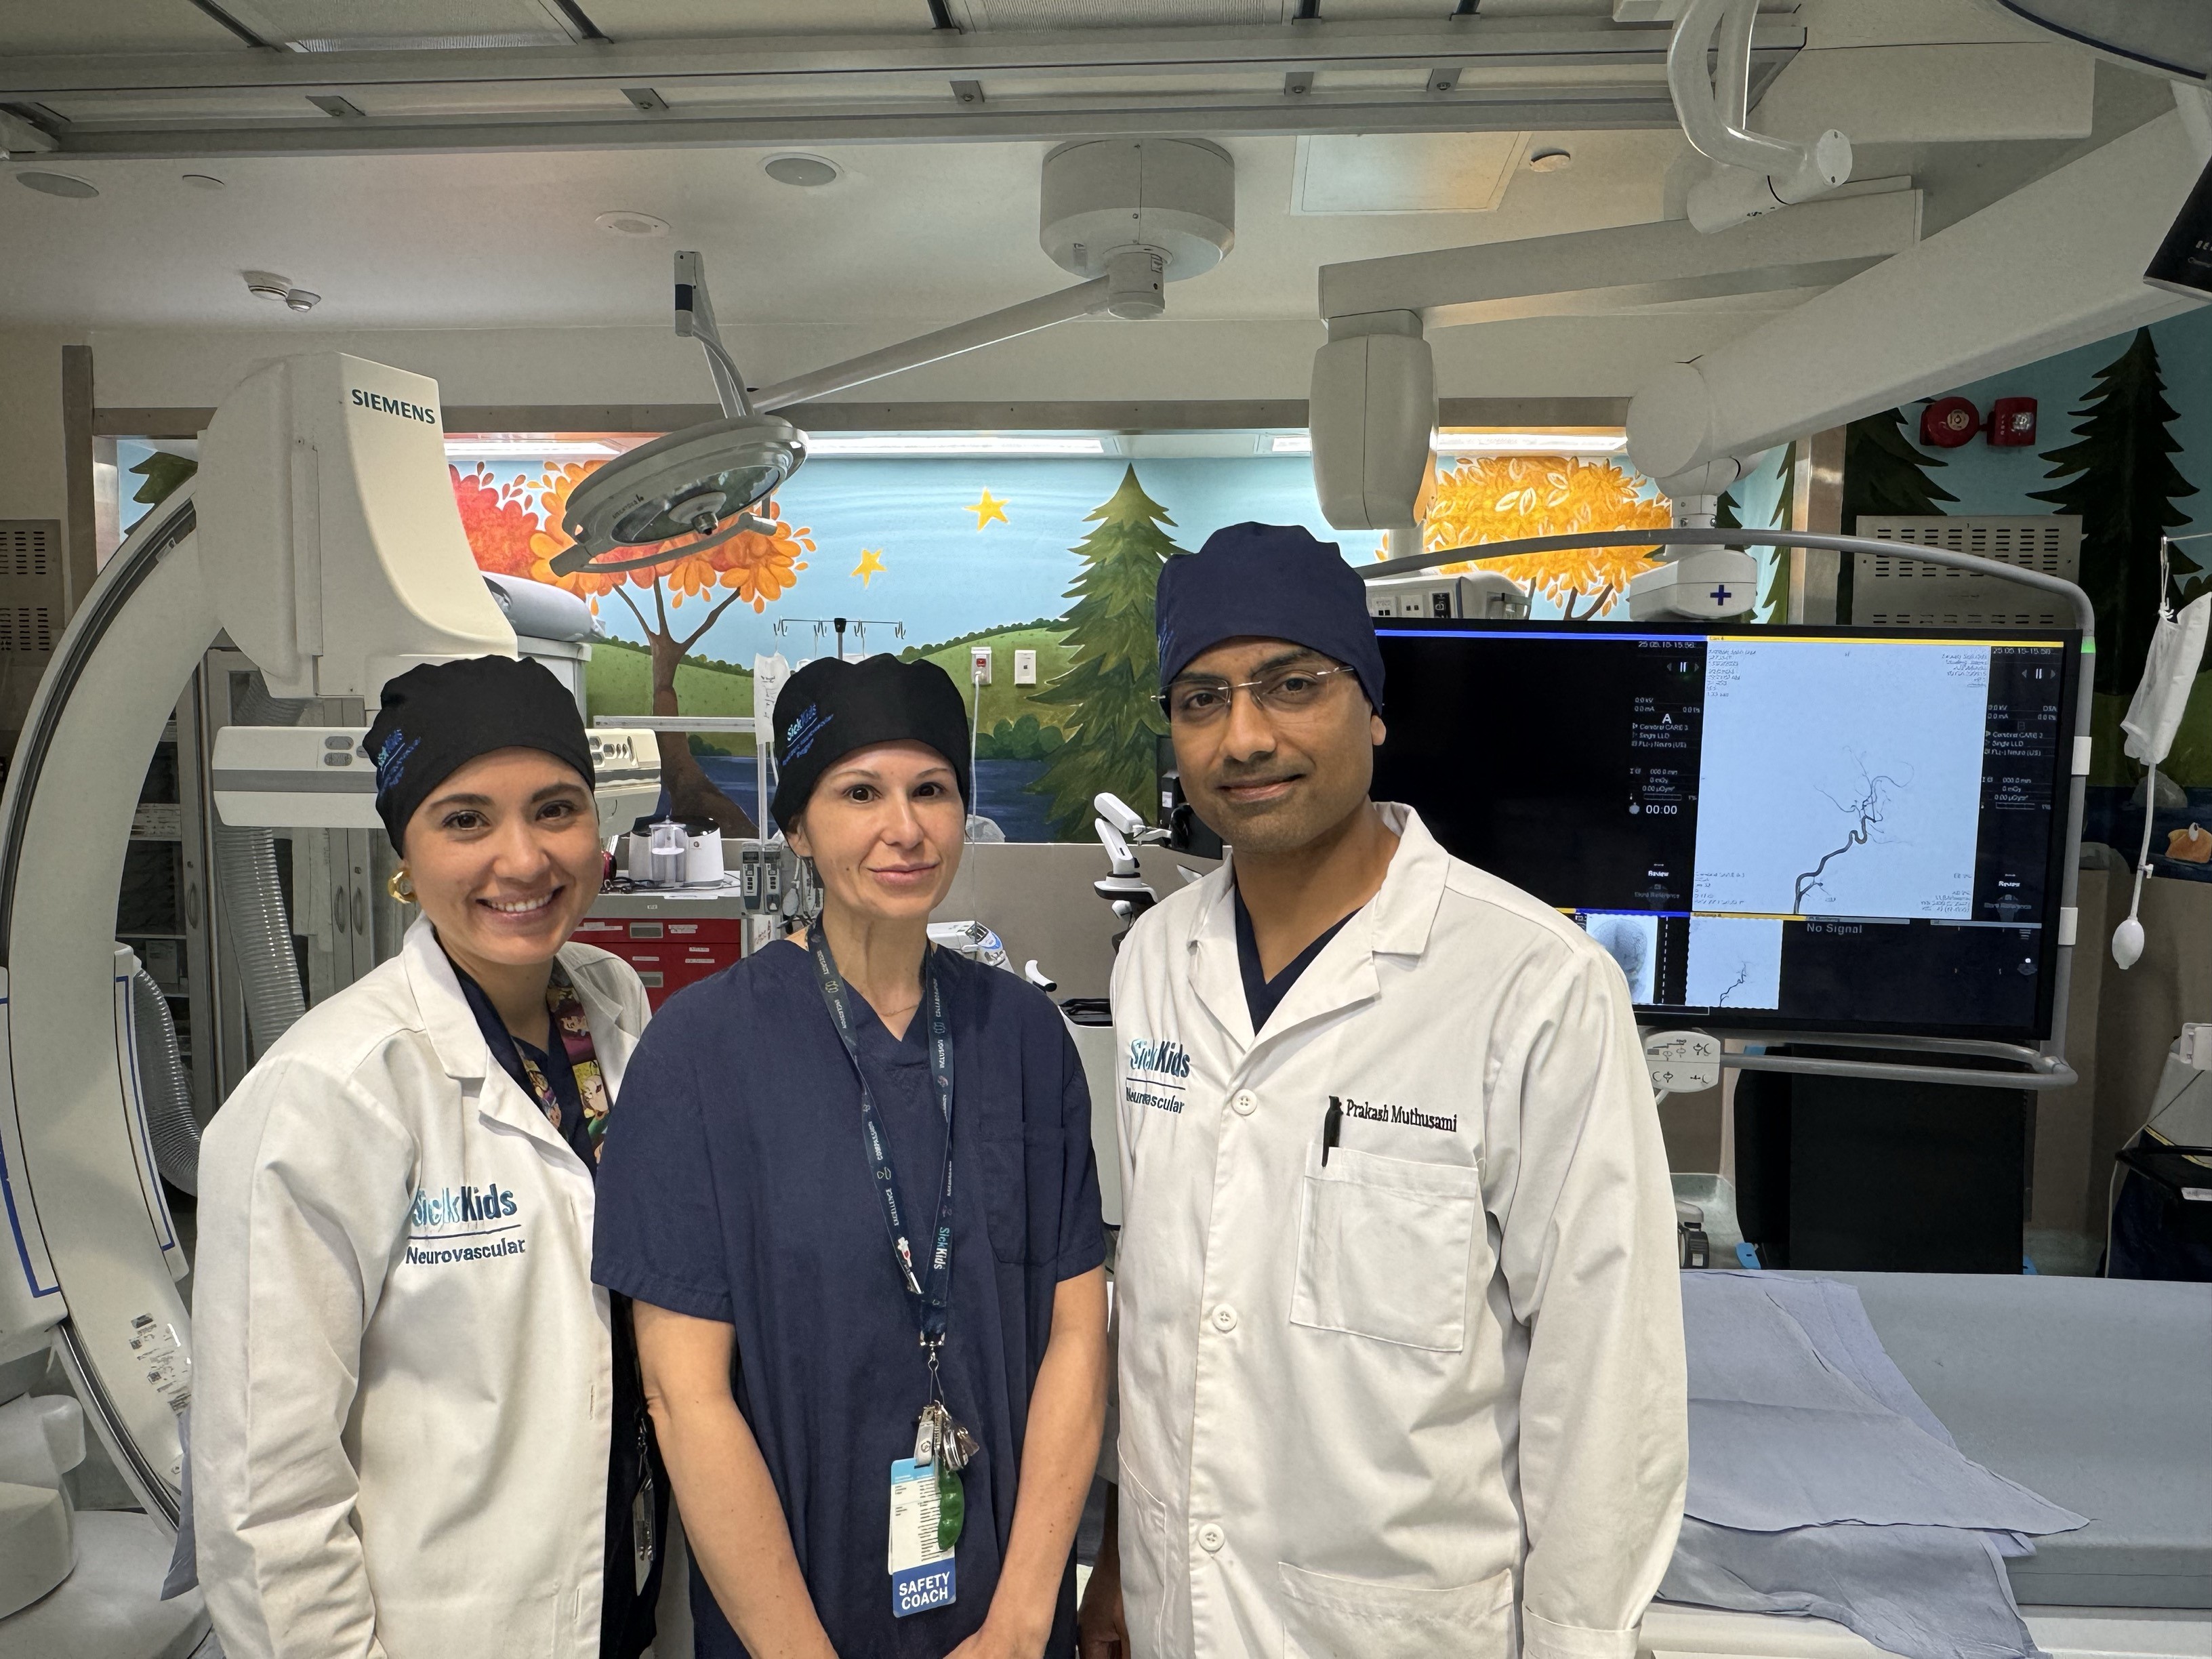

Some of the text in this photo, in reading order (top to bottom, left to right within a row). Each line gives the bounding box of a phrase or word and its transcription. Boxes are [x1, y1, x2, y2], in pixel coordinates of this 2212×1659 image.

[352, 389, 436, 424] SIEMENS
[1662, 713, 1672, 724] A
[1645, 805, 1677, 814] 00:00
[1806, 923, 1862, 935] No Signal
[1346, 1099, 1457, 1132] Prakash Muthusami
[411, 1183, 518, 1227] SickKids
[405, 1237, 526, 1265] Neurovascular
[934, 1227, 950, 1269] SickKids
[899, 1571, 950, 1596] SAFETY
[901, 1586, 948, 1610] COACH
